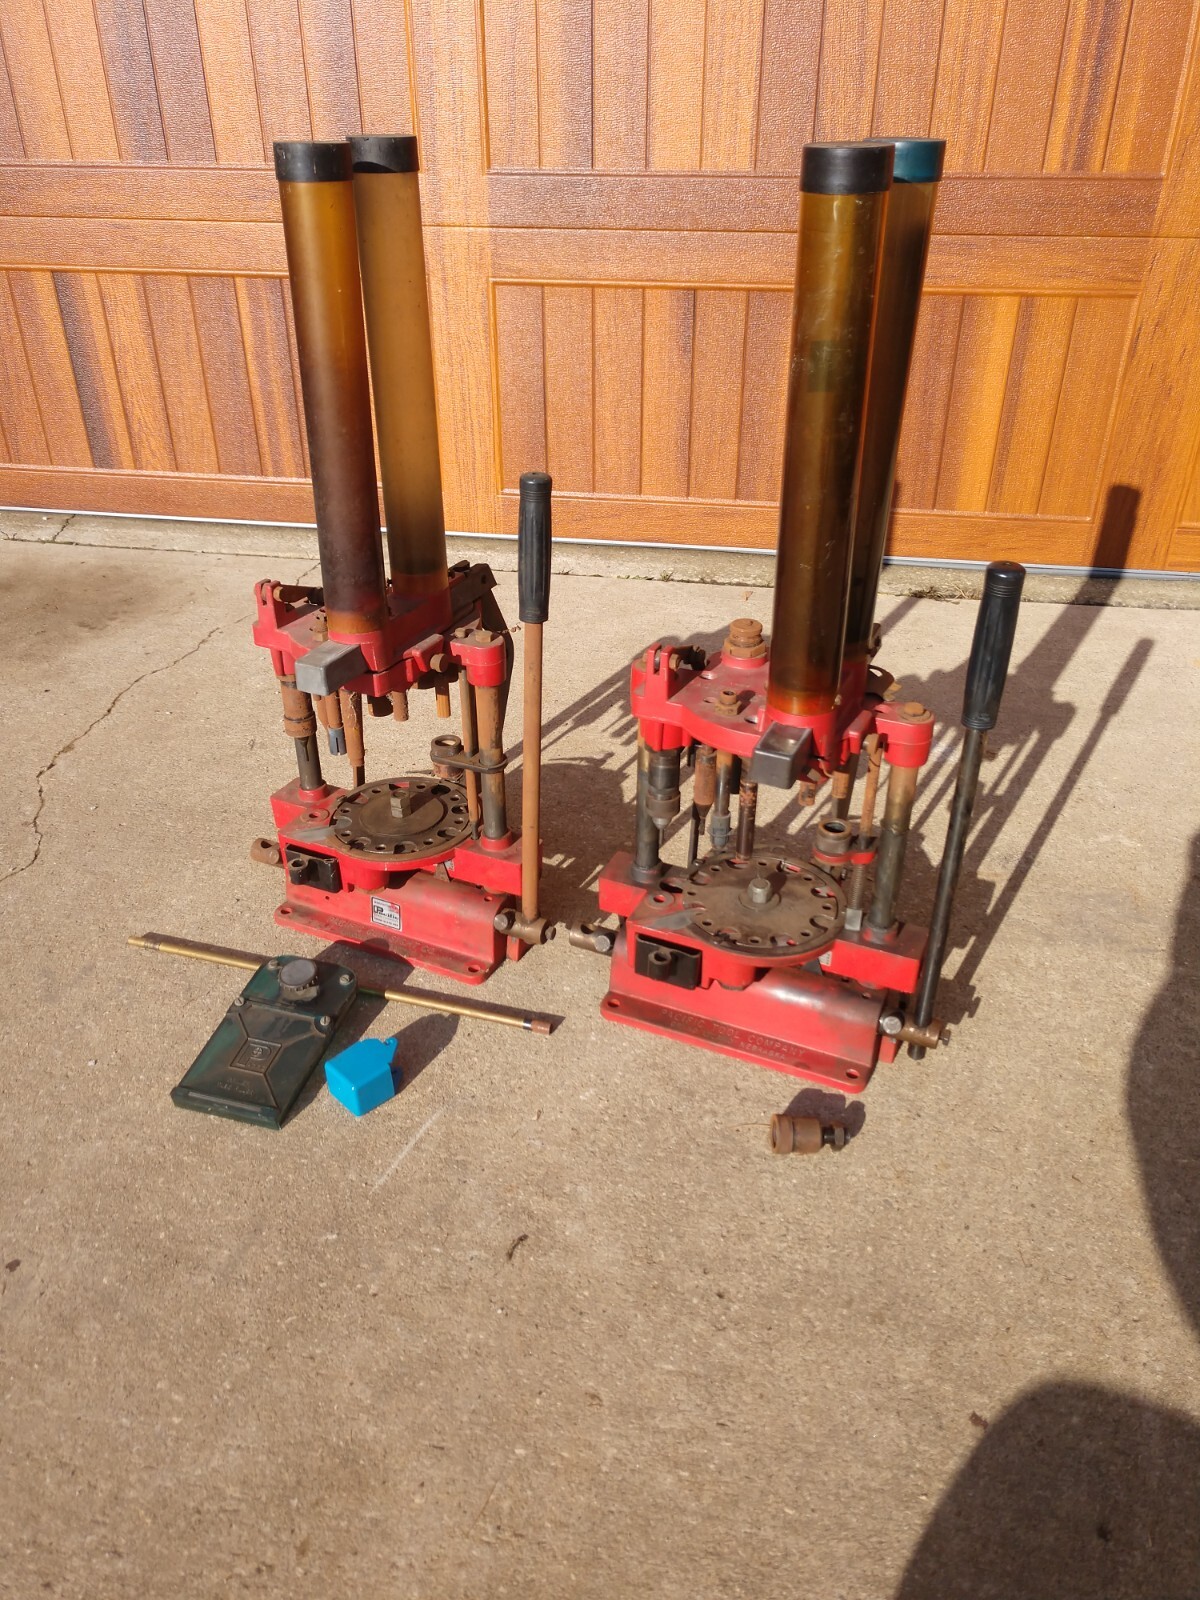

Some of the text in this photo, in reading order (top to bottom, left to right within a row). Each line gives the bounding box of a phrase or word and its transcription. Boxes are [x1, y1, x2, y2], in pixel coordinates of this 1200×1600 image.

[661, 1008, 705, 1028] PACIFIC
[712, 1023, 740, 1039] TOOL
[747, 1034, 806, 1057] COMPANY
